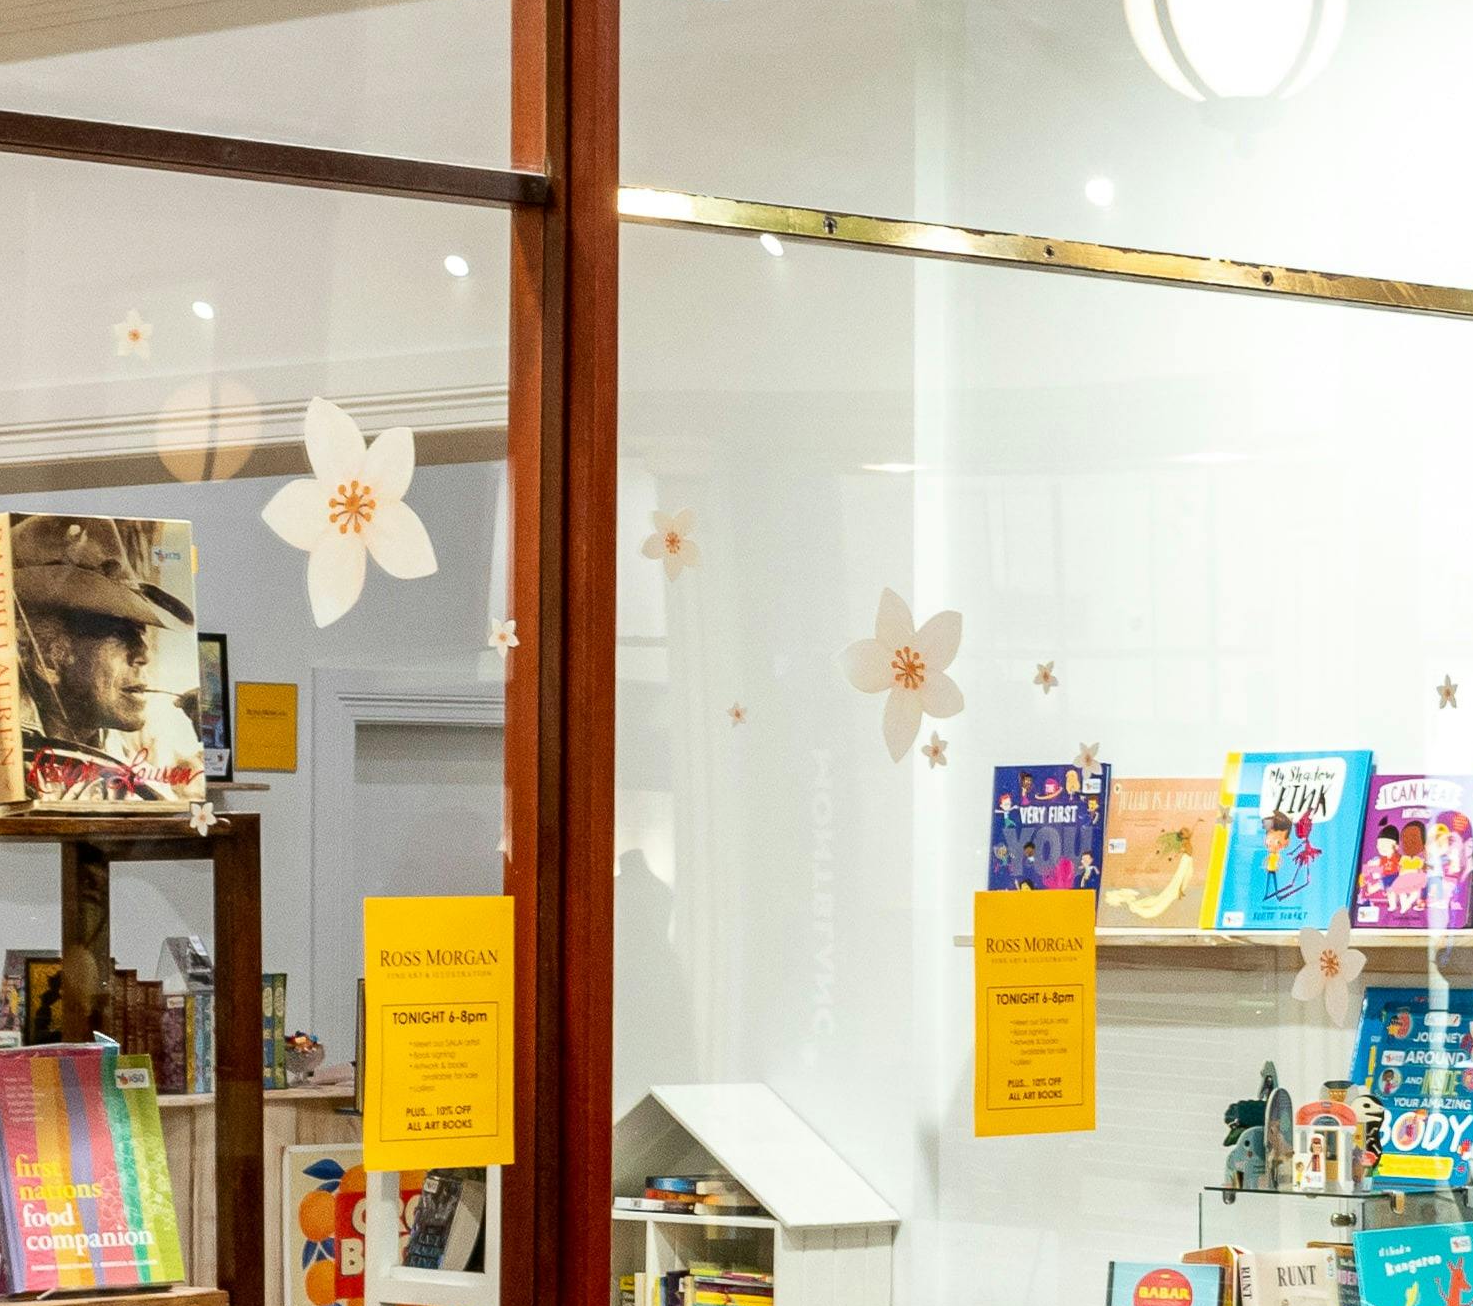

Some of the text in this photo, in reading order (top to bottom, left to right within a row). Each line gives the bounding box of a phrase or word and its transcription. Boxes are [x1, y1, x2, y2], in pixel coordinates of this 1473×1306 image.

[1390, 784, 1418, 803] CAN
[1019, 805, 1079, 824] VERY FIRST
[1002, 825, 1094, 877] YOU
[986, 936, 1084, 954] ROSS MORGAN
[380, 948, 499, 968] ROSS MORGAN
[996, 992, 1075, 1006] TONIGHT 6-8pm
[392, 1010, 489, 1026] TONIGHT 6-8pm
[1412, 1032, 1464, 1044] JOURNEY
[1405, 1049, 1466, 1066] AROUND
[1008, 1090, 1063, 1101] ALL ART BOOKS
[1393, 1096, 1472, 1111] YOUR AMAZING
[454, 1104, 472, 1116] OFF
[406, 1118, 473, 1131] ALL ART BOOKS
[14, 1154, 63, 1178] first
[18, 1181, 103, 1201] nations
[22, 1202, 76, 1227] food
[26, 1225, 155, 1255] companion
[1384, 1253, 1442, 1277] kangaroo
[1240, 1264, 1253, 1301] RUNT
[1276, 1265, 1317, 1288] RUNT
[1137, 1285, 1191, 1302] BABAR
